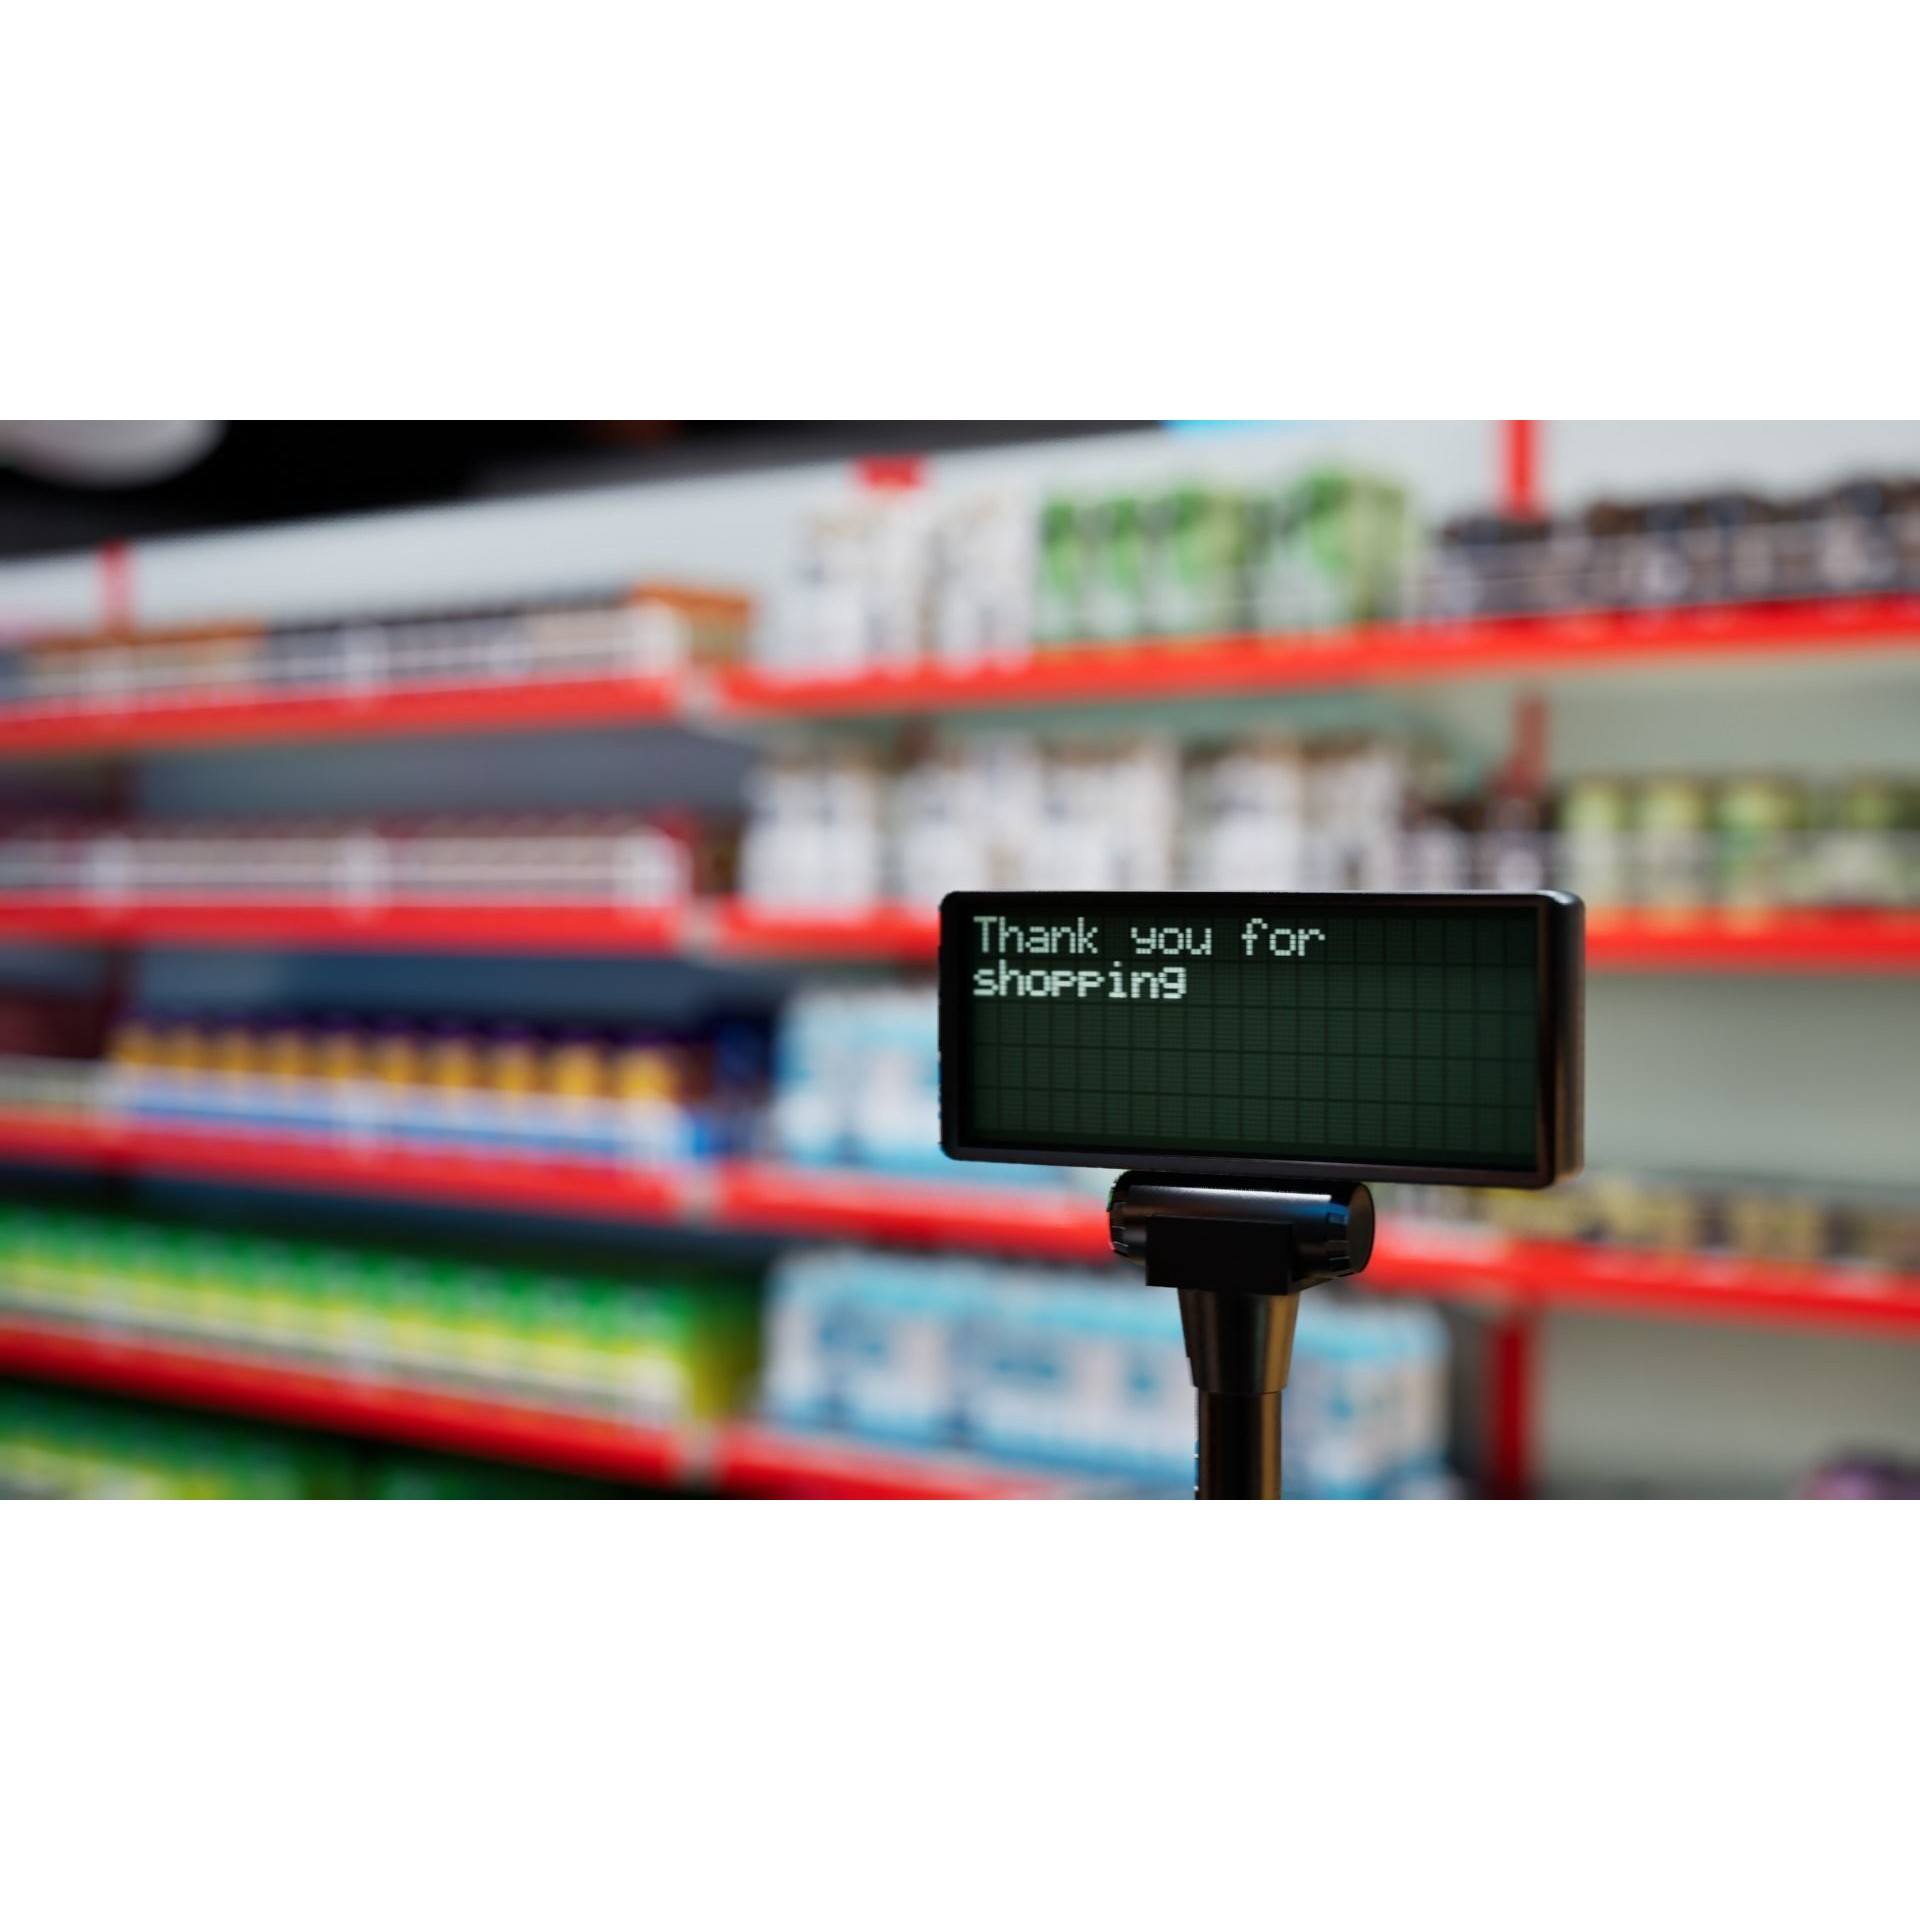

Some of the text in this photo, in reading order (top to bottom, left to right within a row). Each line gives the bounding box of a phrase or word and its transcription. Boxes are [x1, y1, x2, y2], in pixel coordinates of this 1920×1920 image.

[973, 916, 1326, 956] Thank you for
[973, 959, 1187, 999] shopping
